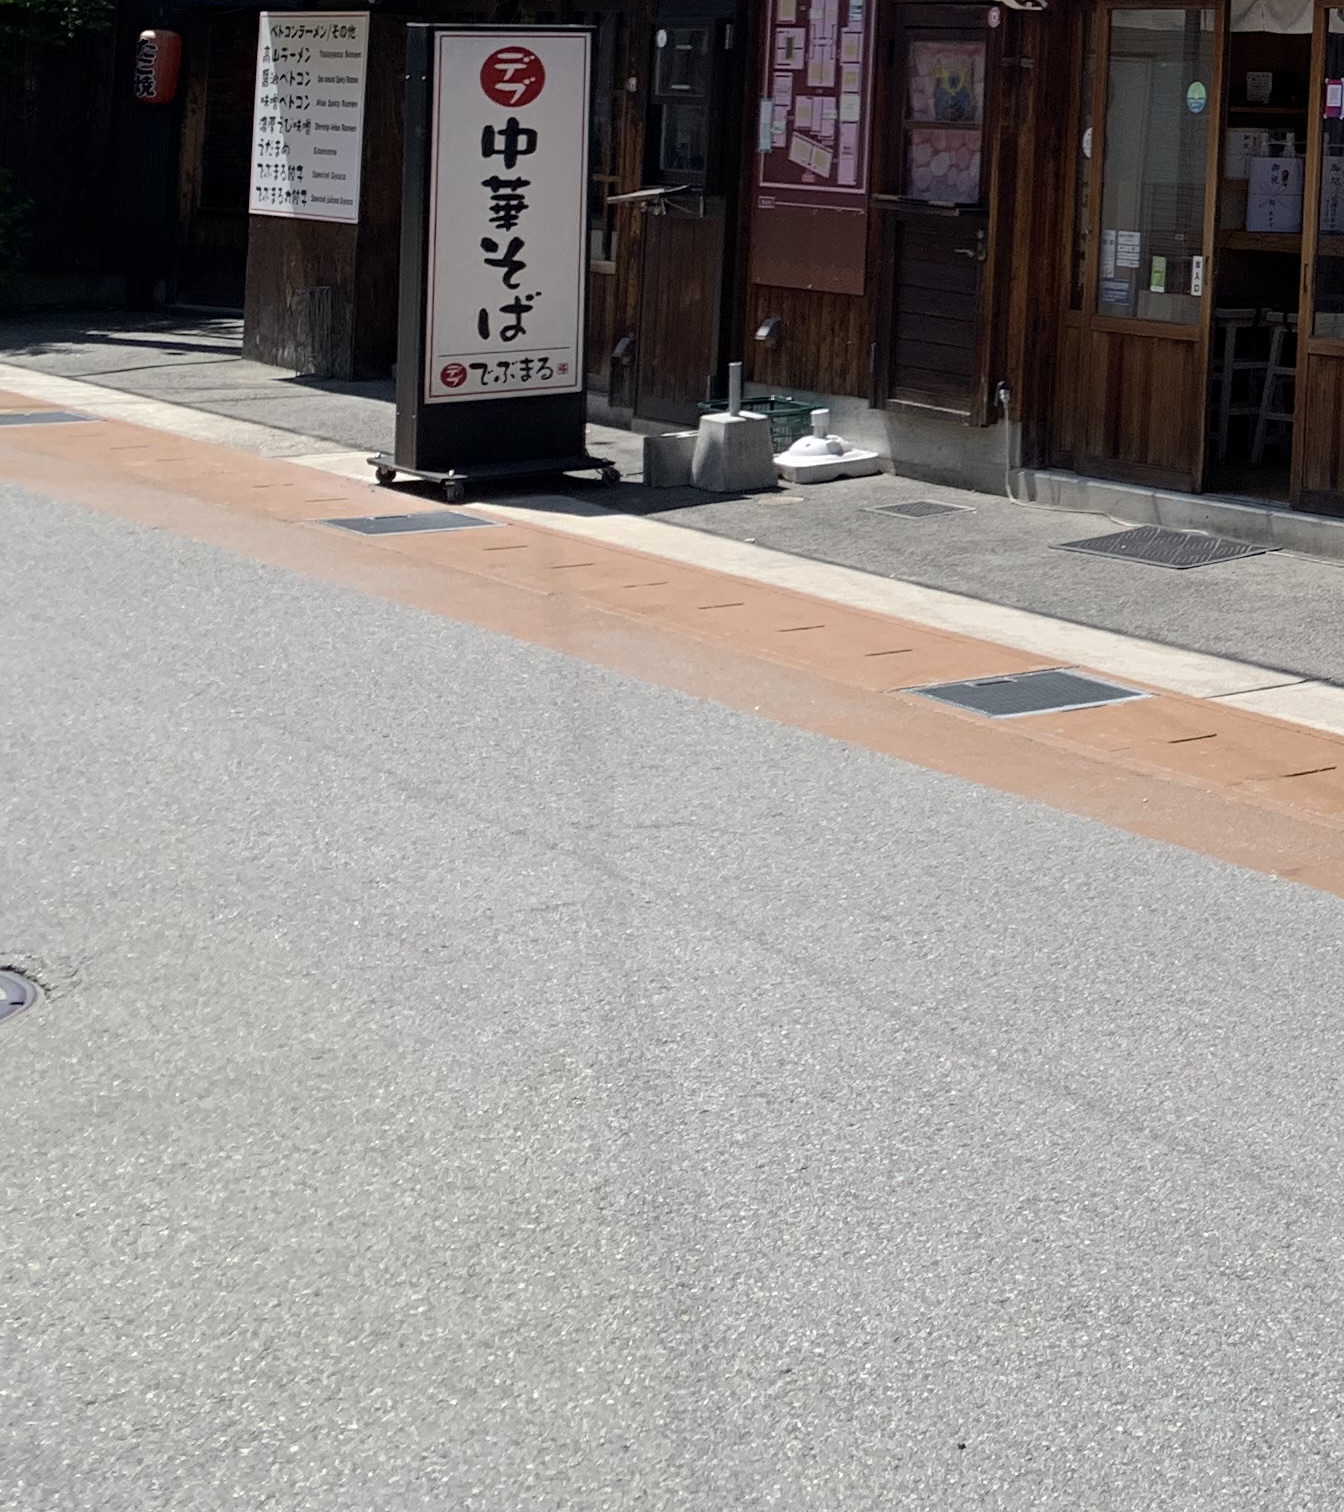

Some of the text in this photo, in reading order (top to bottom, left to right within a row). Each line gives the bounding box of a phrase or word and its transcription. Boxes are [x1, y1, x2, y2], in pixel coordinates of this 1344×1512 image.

[478, 117, 542, 343] 中華そば
[469, 356, 554, 386] でぶまる
